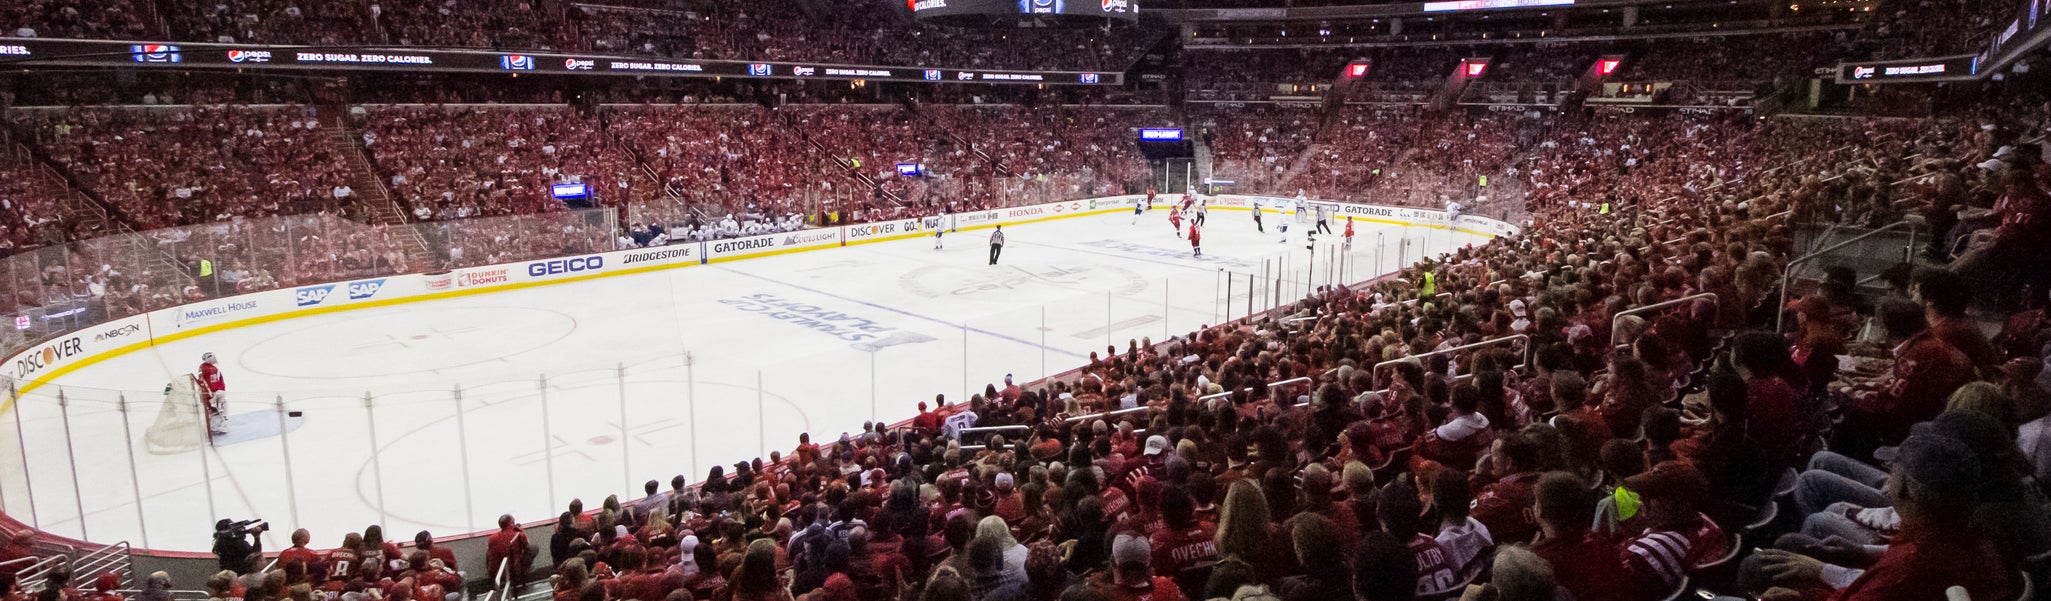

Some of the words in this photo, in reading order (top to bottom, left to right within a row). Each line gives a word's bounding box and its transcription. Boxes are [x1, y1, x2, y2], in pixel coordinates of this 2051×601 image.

[297, 53, 323, 61] ZERO
[325, 53, 360, 62] SUGAR.
[361, 54, 386, 63] ZERO
[387, 55, 432, 64] CALORIES.
[654, 62, 671, 70] ZERO
[1008, 207, 1044, 218] HONDA
[1345, 205, 1393, 217] GATORADE
[851, 224, 895, 238] DISCOVER
[714, 237, 774, 253] GATORADE
[791, 232, 816, 245] Coors
[816, 232, 836, 241] LIGHT
[623, 247, 690, 264] BRIDGESTONE
[528, 255, 603, 277] GEICO
[472, 275, 508, 285] DONUTS
[297, 289, 330, 306] SAP
[350, 282, 380, 299] SAP
[17, 337, 83, 378] DISCOVER
